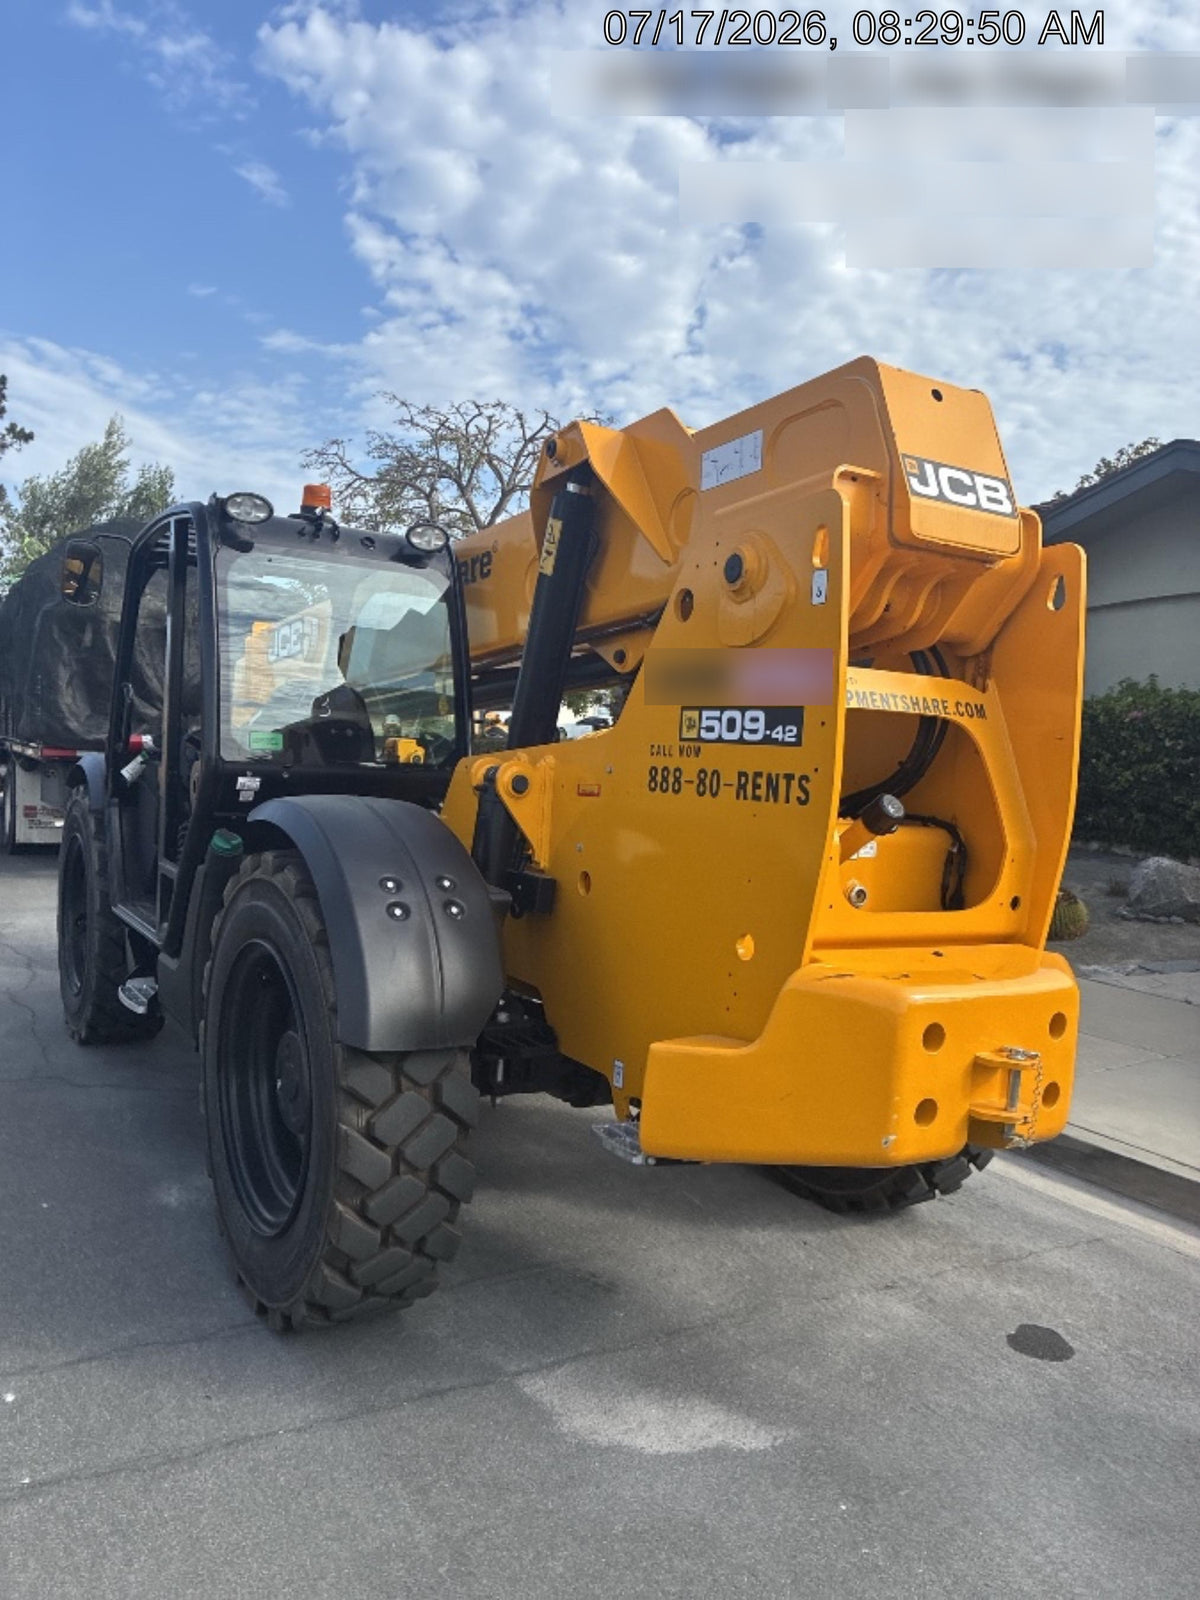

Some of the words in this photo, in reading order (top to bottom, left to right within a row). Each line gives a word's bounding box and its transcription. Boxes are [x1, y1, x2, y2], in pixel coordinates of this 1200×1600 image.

[908, 462, 1013, 514] JCB
[650, 744, 673, 757] CALL
[679, 746, 701, 758] NOW
[648, 765, 811, 806] 888-80-RENTS
